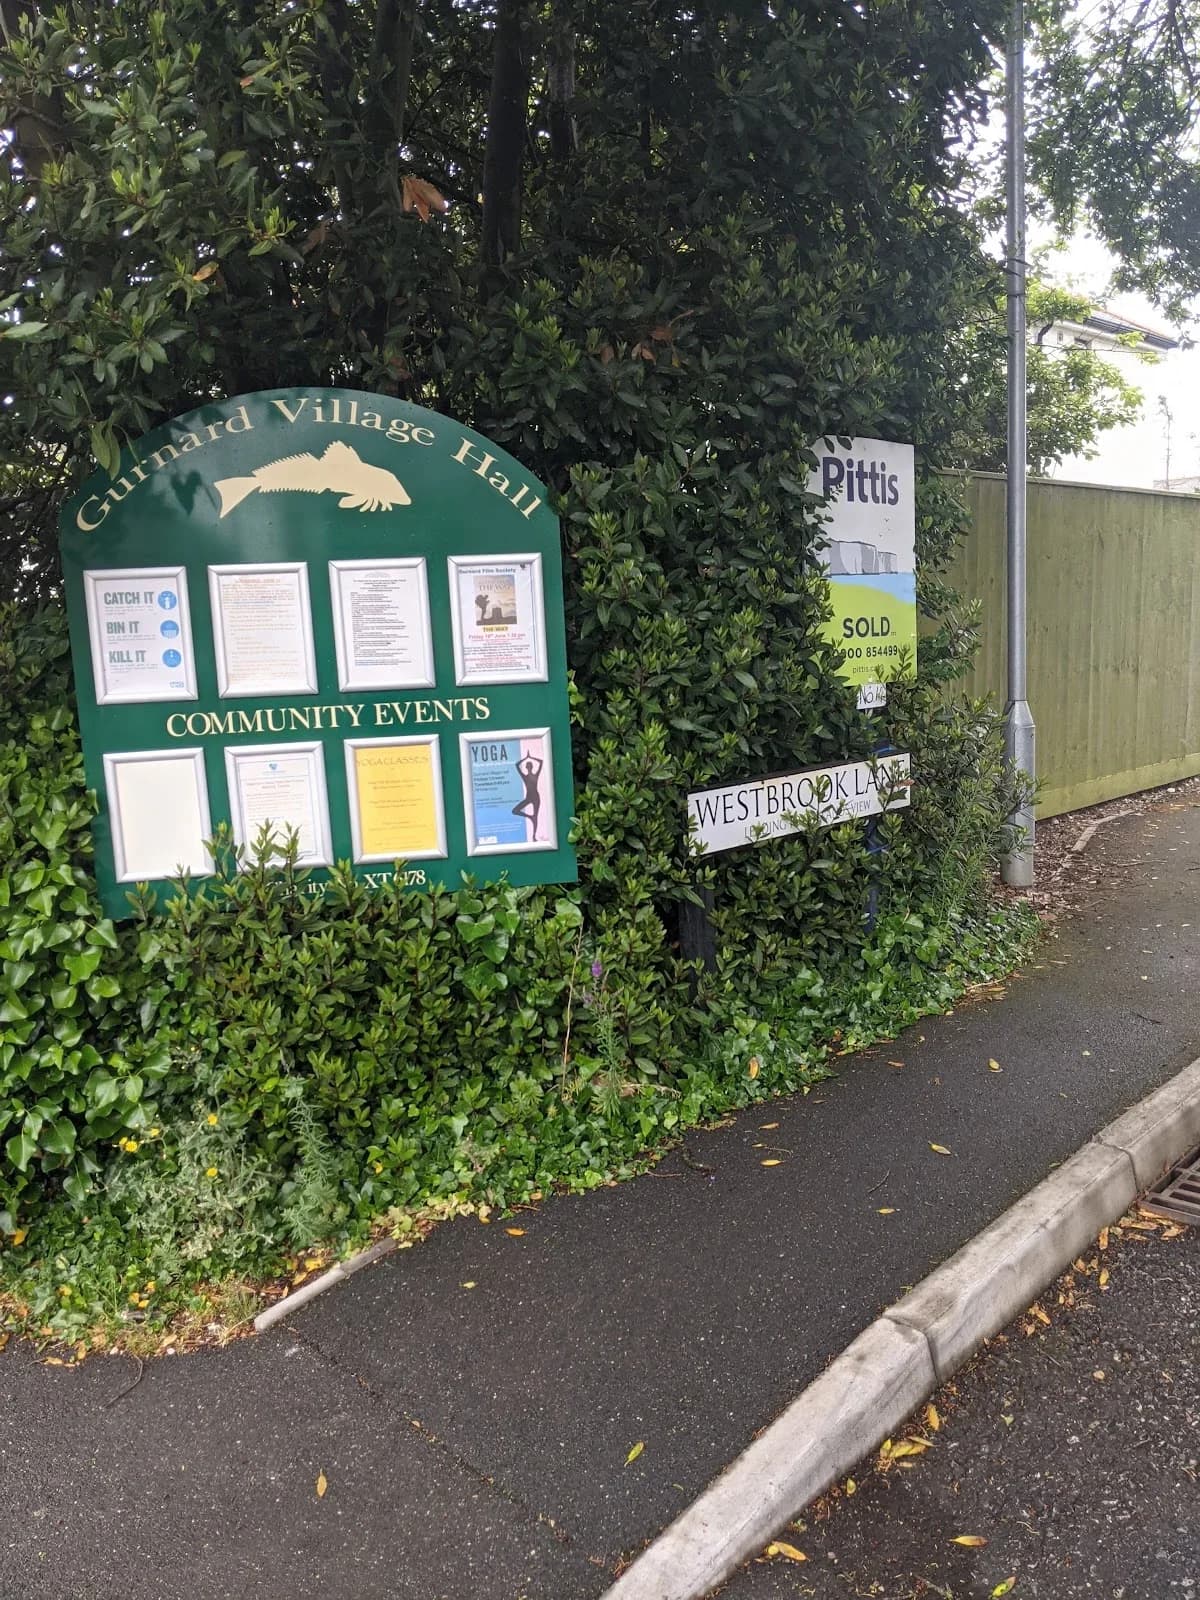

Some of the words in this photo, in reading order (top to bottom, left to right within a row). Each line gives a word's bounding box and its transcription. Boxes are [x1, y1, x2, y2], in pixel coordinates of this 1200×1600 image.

[76, 406, 254, 532] Gurnard
[270, 398, 435, 446] Village
[450, 437, 543, 520] Hall
[822, 456, 899, 506] Pittis
[103, 591, 140, 606] CATCH
[143, 591, 154, 604] IT
[106, 621, 125, 635] BIN
[128, 621, 140, 634] IT
[842, 616, 891, 639] SOLD
[108, 650, 133, 664] KILL
[135, 650, 147, 663] IT
[866, 644, 898, 658] 854499
[852, 664, 885, 675] pittis.c
[166, 703, 365, 738] COMMUNITY
[374, 696, 491, 726] EVENTS
[471, 744, 509, 763] YOGA
[695, 770, 849, 829] WESTBROOK
[744, 818, 788, 839] LEDING
